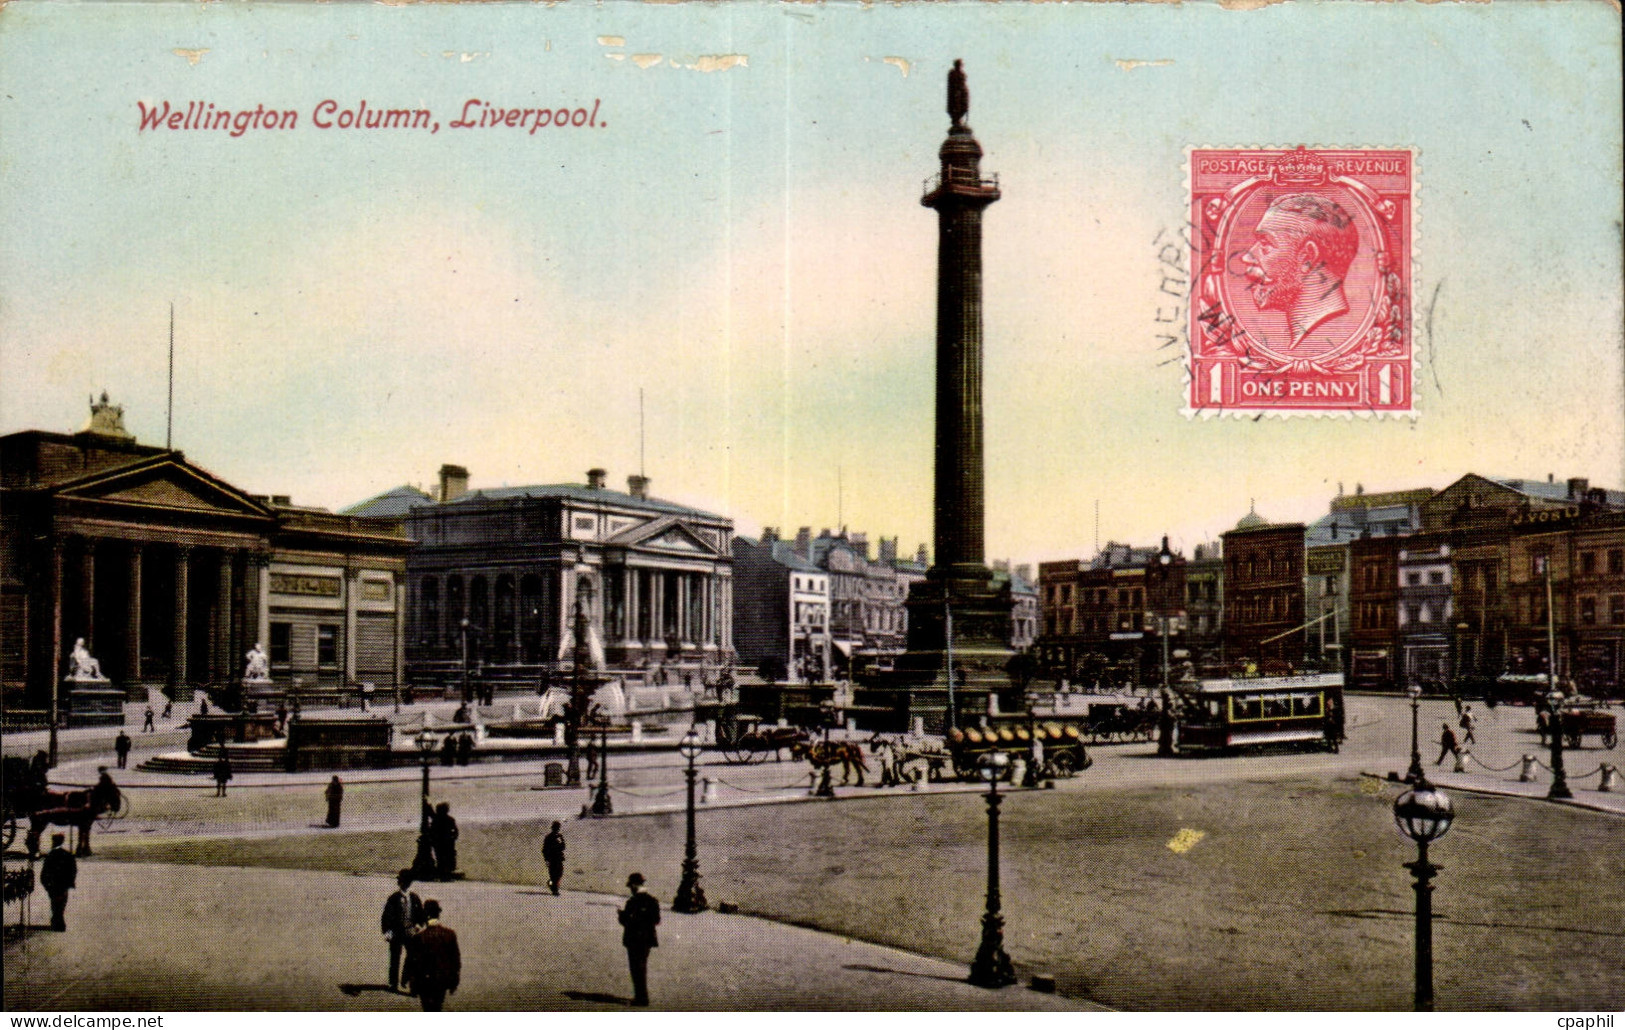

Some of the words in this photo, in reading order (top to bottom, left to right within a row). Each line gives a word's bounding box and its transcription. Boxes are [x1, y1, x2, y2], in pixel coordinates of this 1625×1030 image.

[1200, 159, 1266, 174] POSTAGE
[1335, 159, 1402, 173] REVENUE
[1209, 362, 1222, 404] 1
[1242, 380, 1285, 397] ONE
[1288, 380, 1359, 397] PENNY
[1377, 363, 1392, 405] 1
